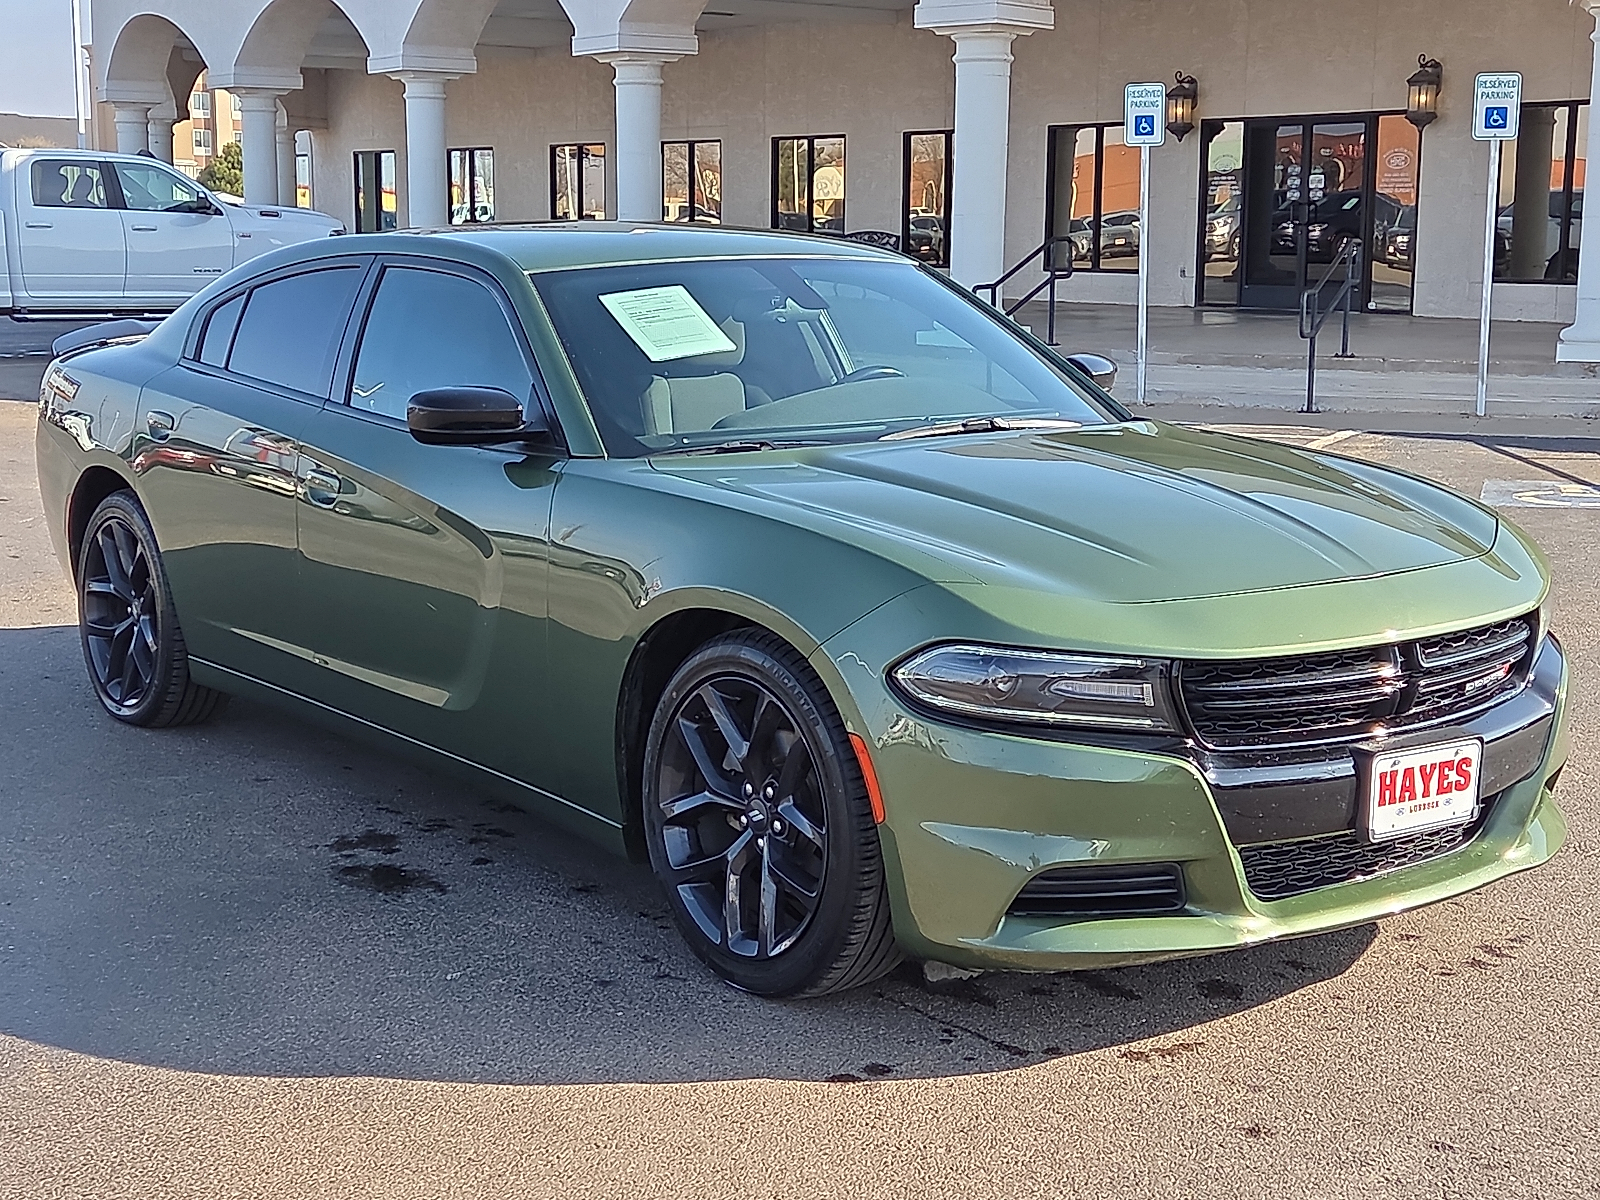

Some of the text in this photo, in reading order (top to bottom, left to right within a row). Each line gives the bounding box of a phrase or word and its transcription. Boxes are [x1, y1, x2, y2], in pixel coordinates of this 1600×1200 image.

[1479, 79, 1517, 88] RESERVED
[1129, 89, 1161, 98] RESERVED
[1481, 91, 1514, 99] PARKING
[1130, 100, 1159, 108] PARKING
[1378, 756, 1473, 808] HAYES
